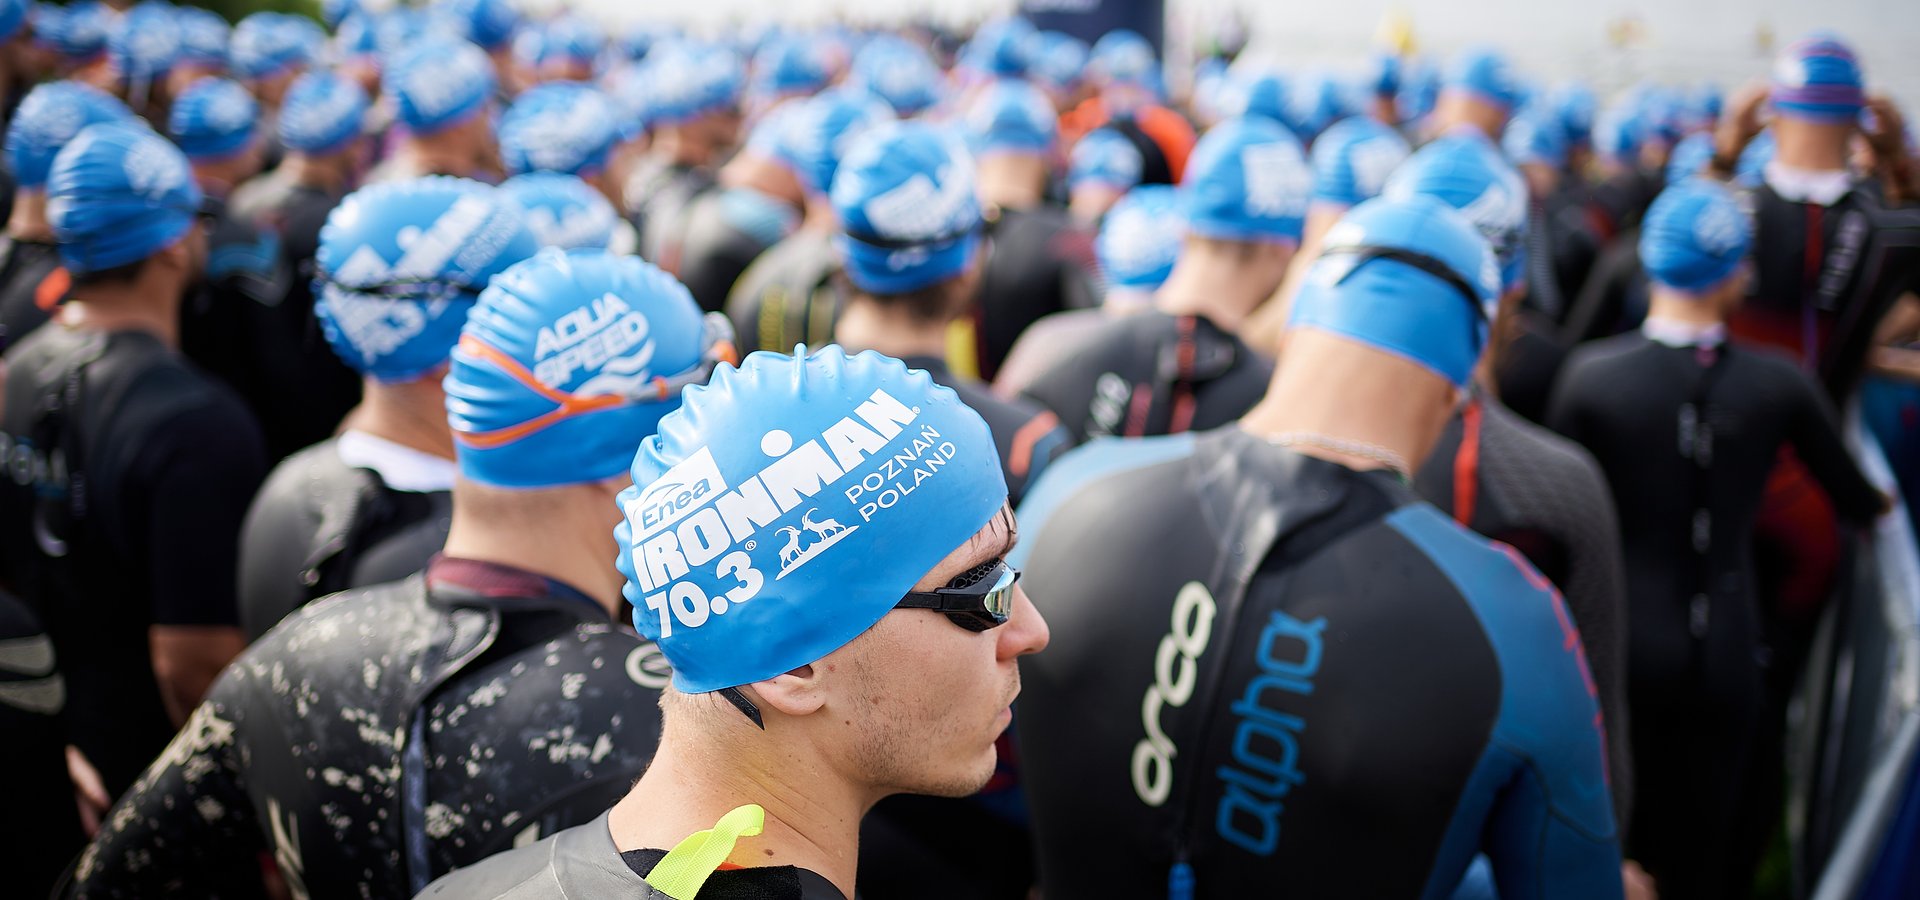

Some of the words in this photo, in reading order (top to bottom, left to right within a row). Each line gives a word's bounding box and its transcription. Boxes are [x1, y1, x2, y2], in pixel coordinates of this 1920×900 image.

[533, 310, 649, 390] SPEED
[534, 292, 630, 361] AQUA
[642, 478, 711, 530] Enea
[844, 424, 941, 505] POZNAŃ
[858, 441, 956, 522] POLAND
[645, 550, 764, 639] 70.3
[1131, 580, 1217, 807] orca
[1215, 609, 1329, 857] alpha
